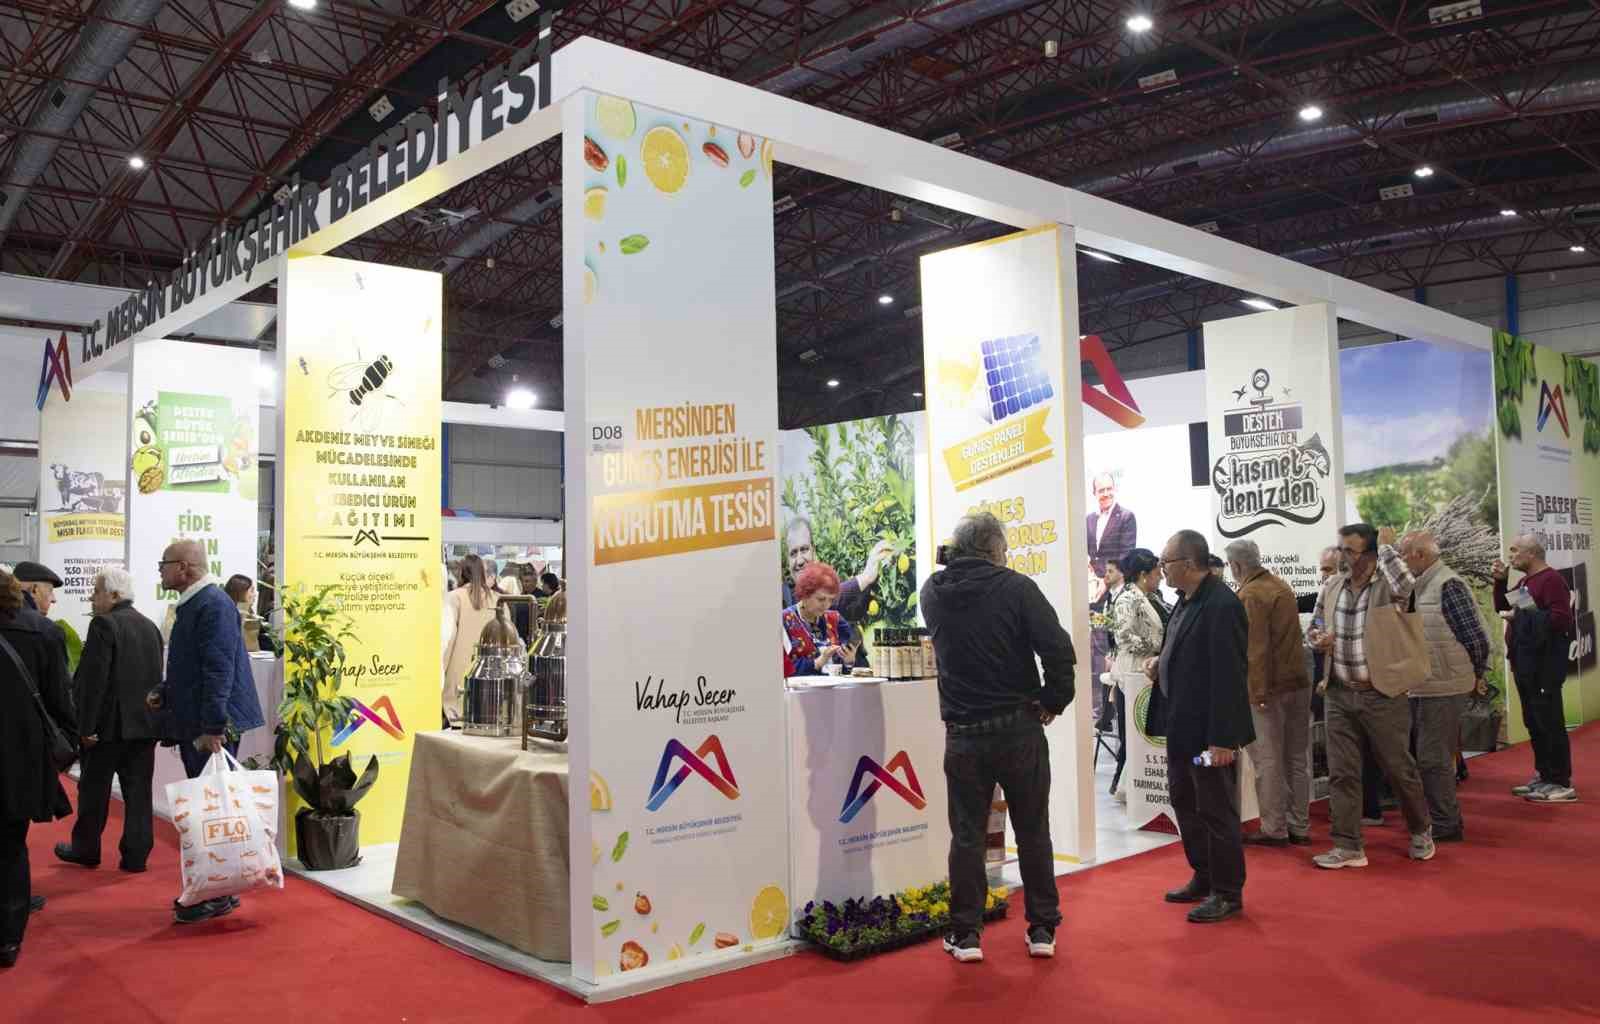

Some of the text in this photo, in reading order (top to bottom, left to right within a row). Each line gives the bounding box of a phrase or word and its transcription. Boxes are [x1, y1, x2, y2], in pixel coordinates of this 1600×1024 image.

[81, 12, 552, 363] T.C. MERSİN BÜYÜKŞEHİR BELEDİYESİ
[636, 401, 736, 440] MERSİNDEN
[1242, 410, 1283, 433] DESTEK
[296, 429, 351, 445] AKDENİZ
[353, 433, 395, 448] MEYVE
[592, 426, 623, 440] D08
[315, 449, 417, 468] MÜCADELESİNDE
[667, 438, 738, 480] ENERJİSİ
[742, 436, 766, 473] İLE
[328, 472, 406, 488] KULLANILAN
[382, 492, 416, 508] ÜRÜN
[178, 508, 213, 532] FİDE
[326, 509, 415, 528] AĞITIMI
[595, 482, 772, 549] KURUTMA TESİSİ
[1273, 554, 1300, 565] ölçekli
[340, 572, 366, 584] Küçük
[1271, 566, 1317, 575] %100 hibeli
[1291, 579, 1315, 588] çizme
[371, 592, 401, 604] protein
[365, 602, 407, 613] yapıyoruz
[635, 676, 690, 724] Vahap
[1133, 779, 1163, 791] TARIMSAL
[208, 821, 246, 839] FLO
